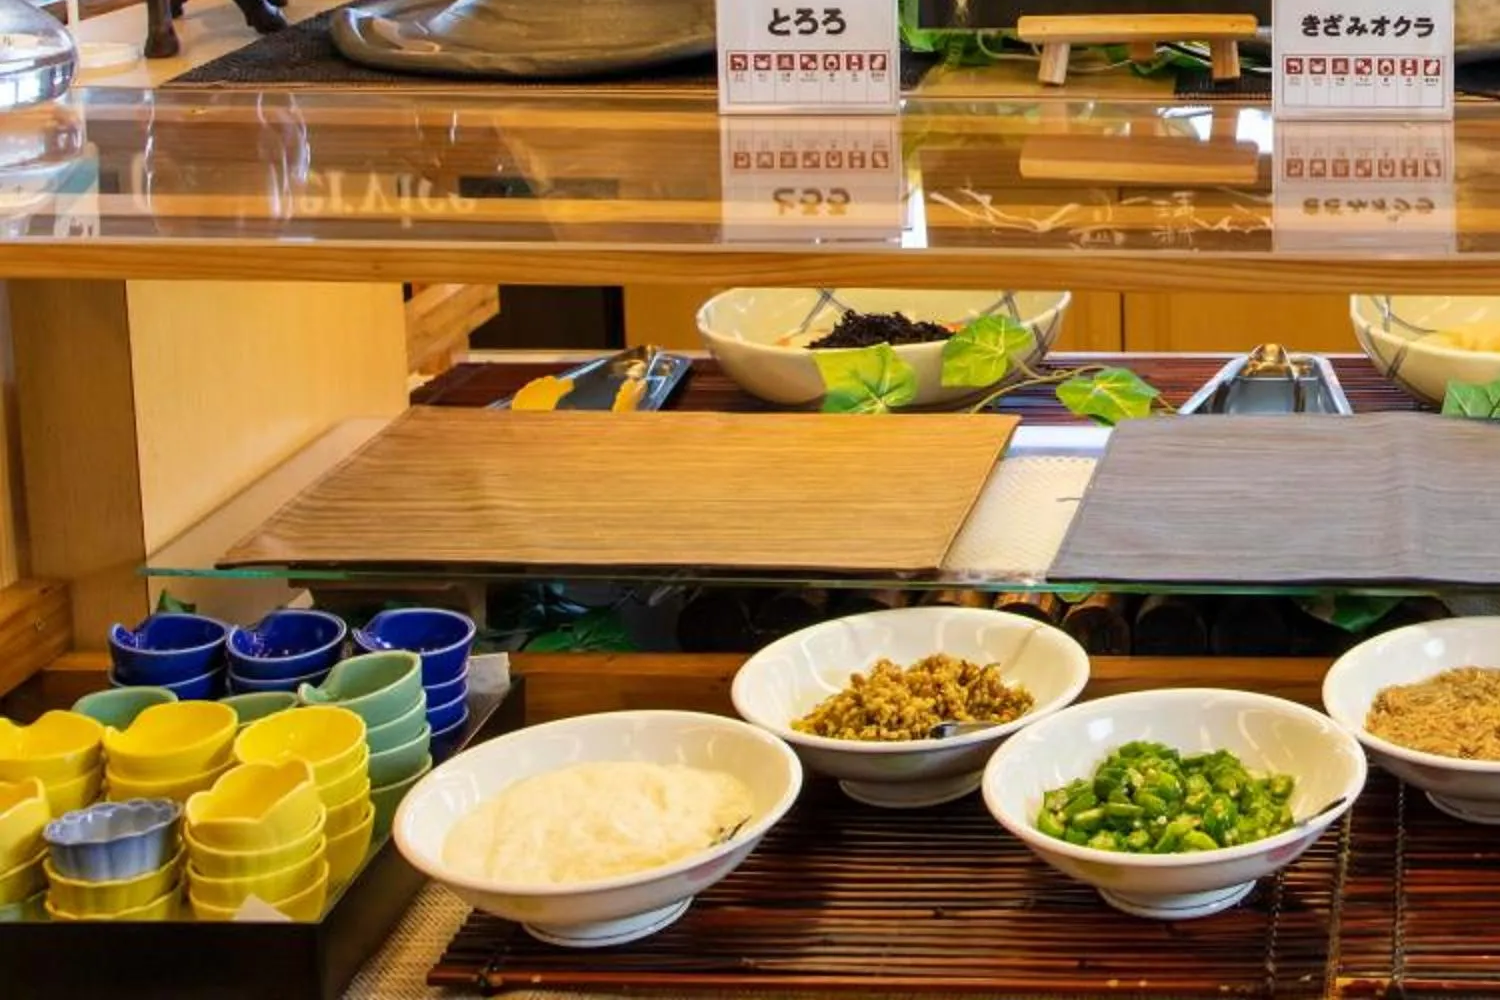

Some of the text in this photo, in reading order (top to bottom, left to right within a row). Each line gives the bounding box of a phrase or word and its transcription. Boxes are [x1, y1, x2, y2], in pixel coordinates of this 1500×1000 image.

[767, 8, 847, 36] とろろ
[1301, 15, 1435, 39] きざみオクラ
